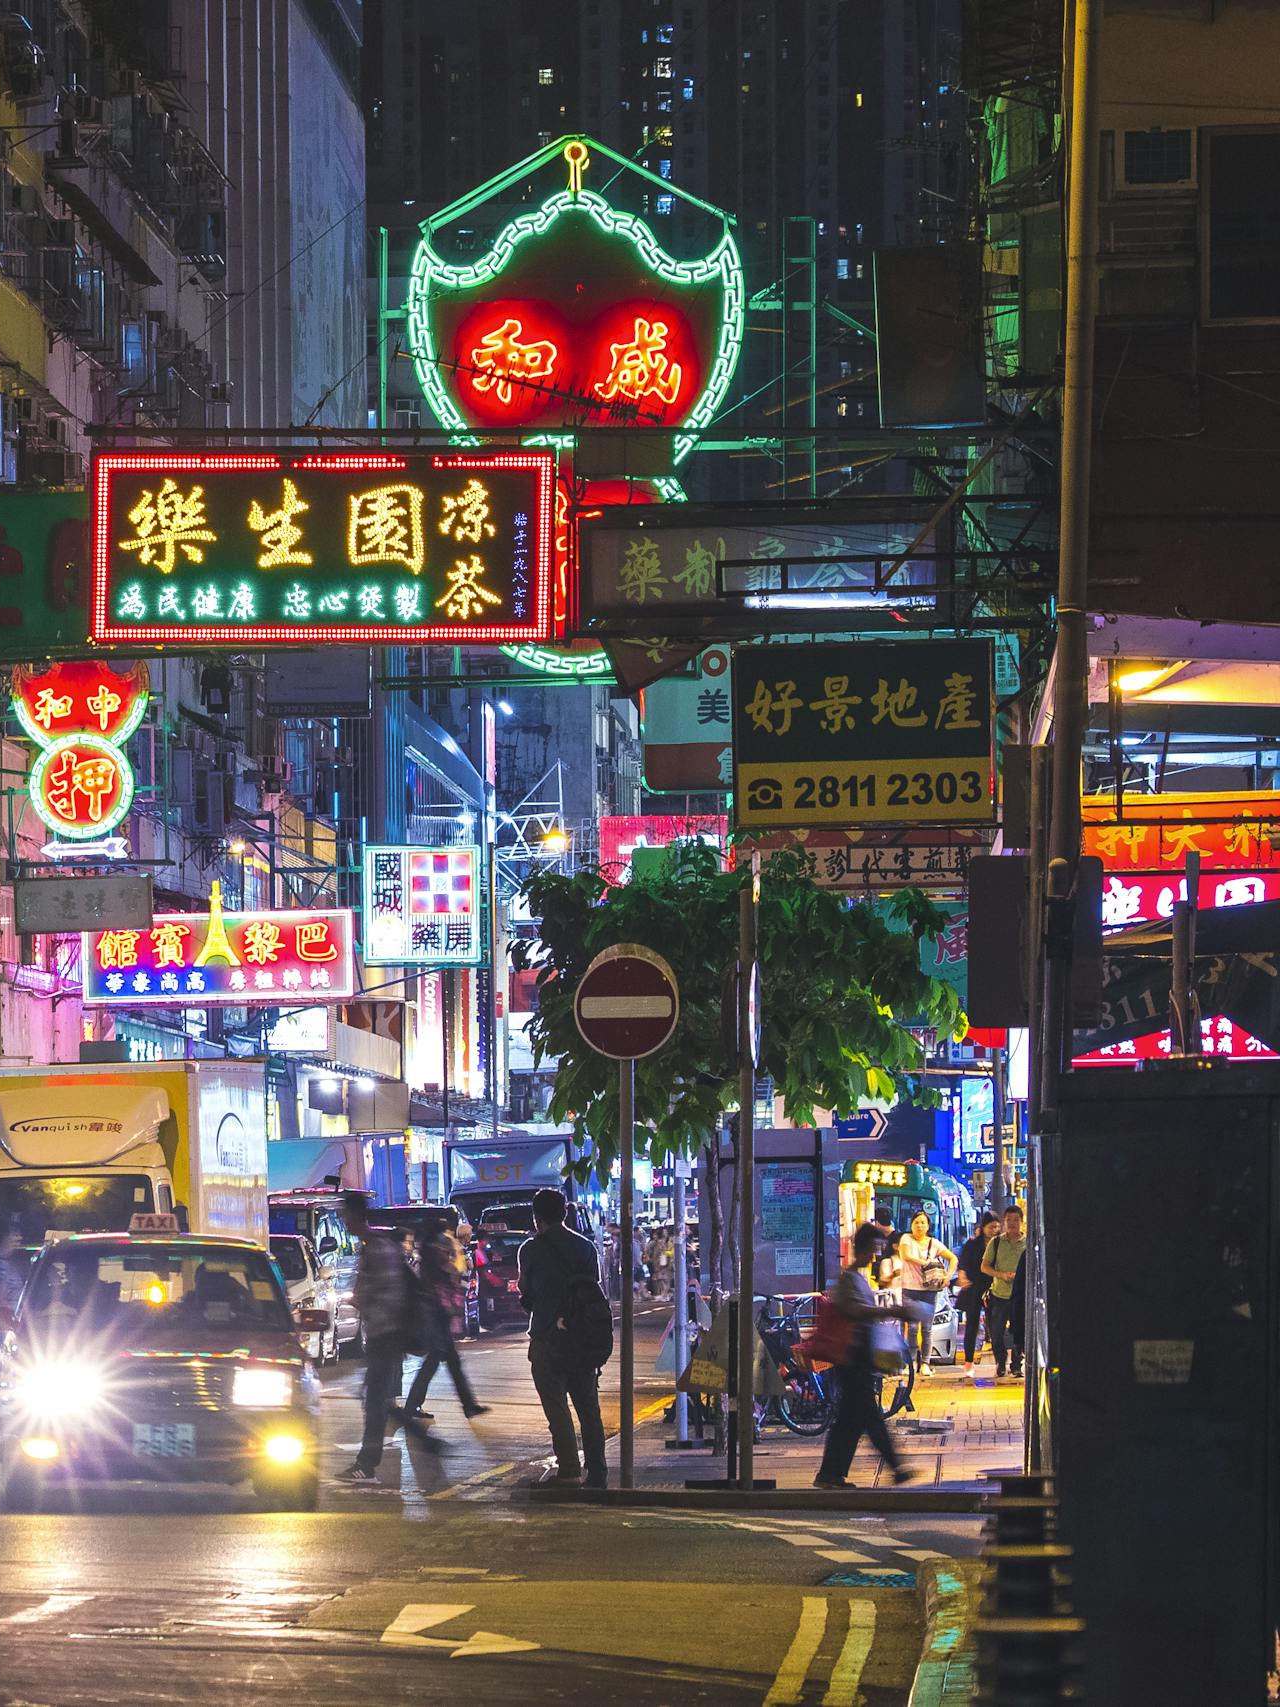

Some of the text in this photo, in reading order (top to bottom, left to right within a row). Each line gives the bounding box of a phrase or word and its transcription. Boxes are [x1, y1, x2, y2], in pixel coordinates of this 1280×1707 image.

[118, 478, 425, 575] 樂生園
[696, 689, 730, 726] 美
[744, 671, 983, 736] 好景地產
[46, 749, 116, 821] 押
[793, 770, 983, 810] 2811 2303
[21, 1122, 87, 1133] Vanquish
[480, 1164, 525, 1182] LST
[135, 1216, 176, 1230] TAXI
